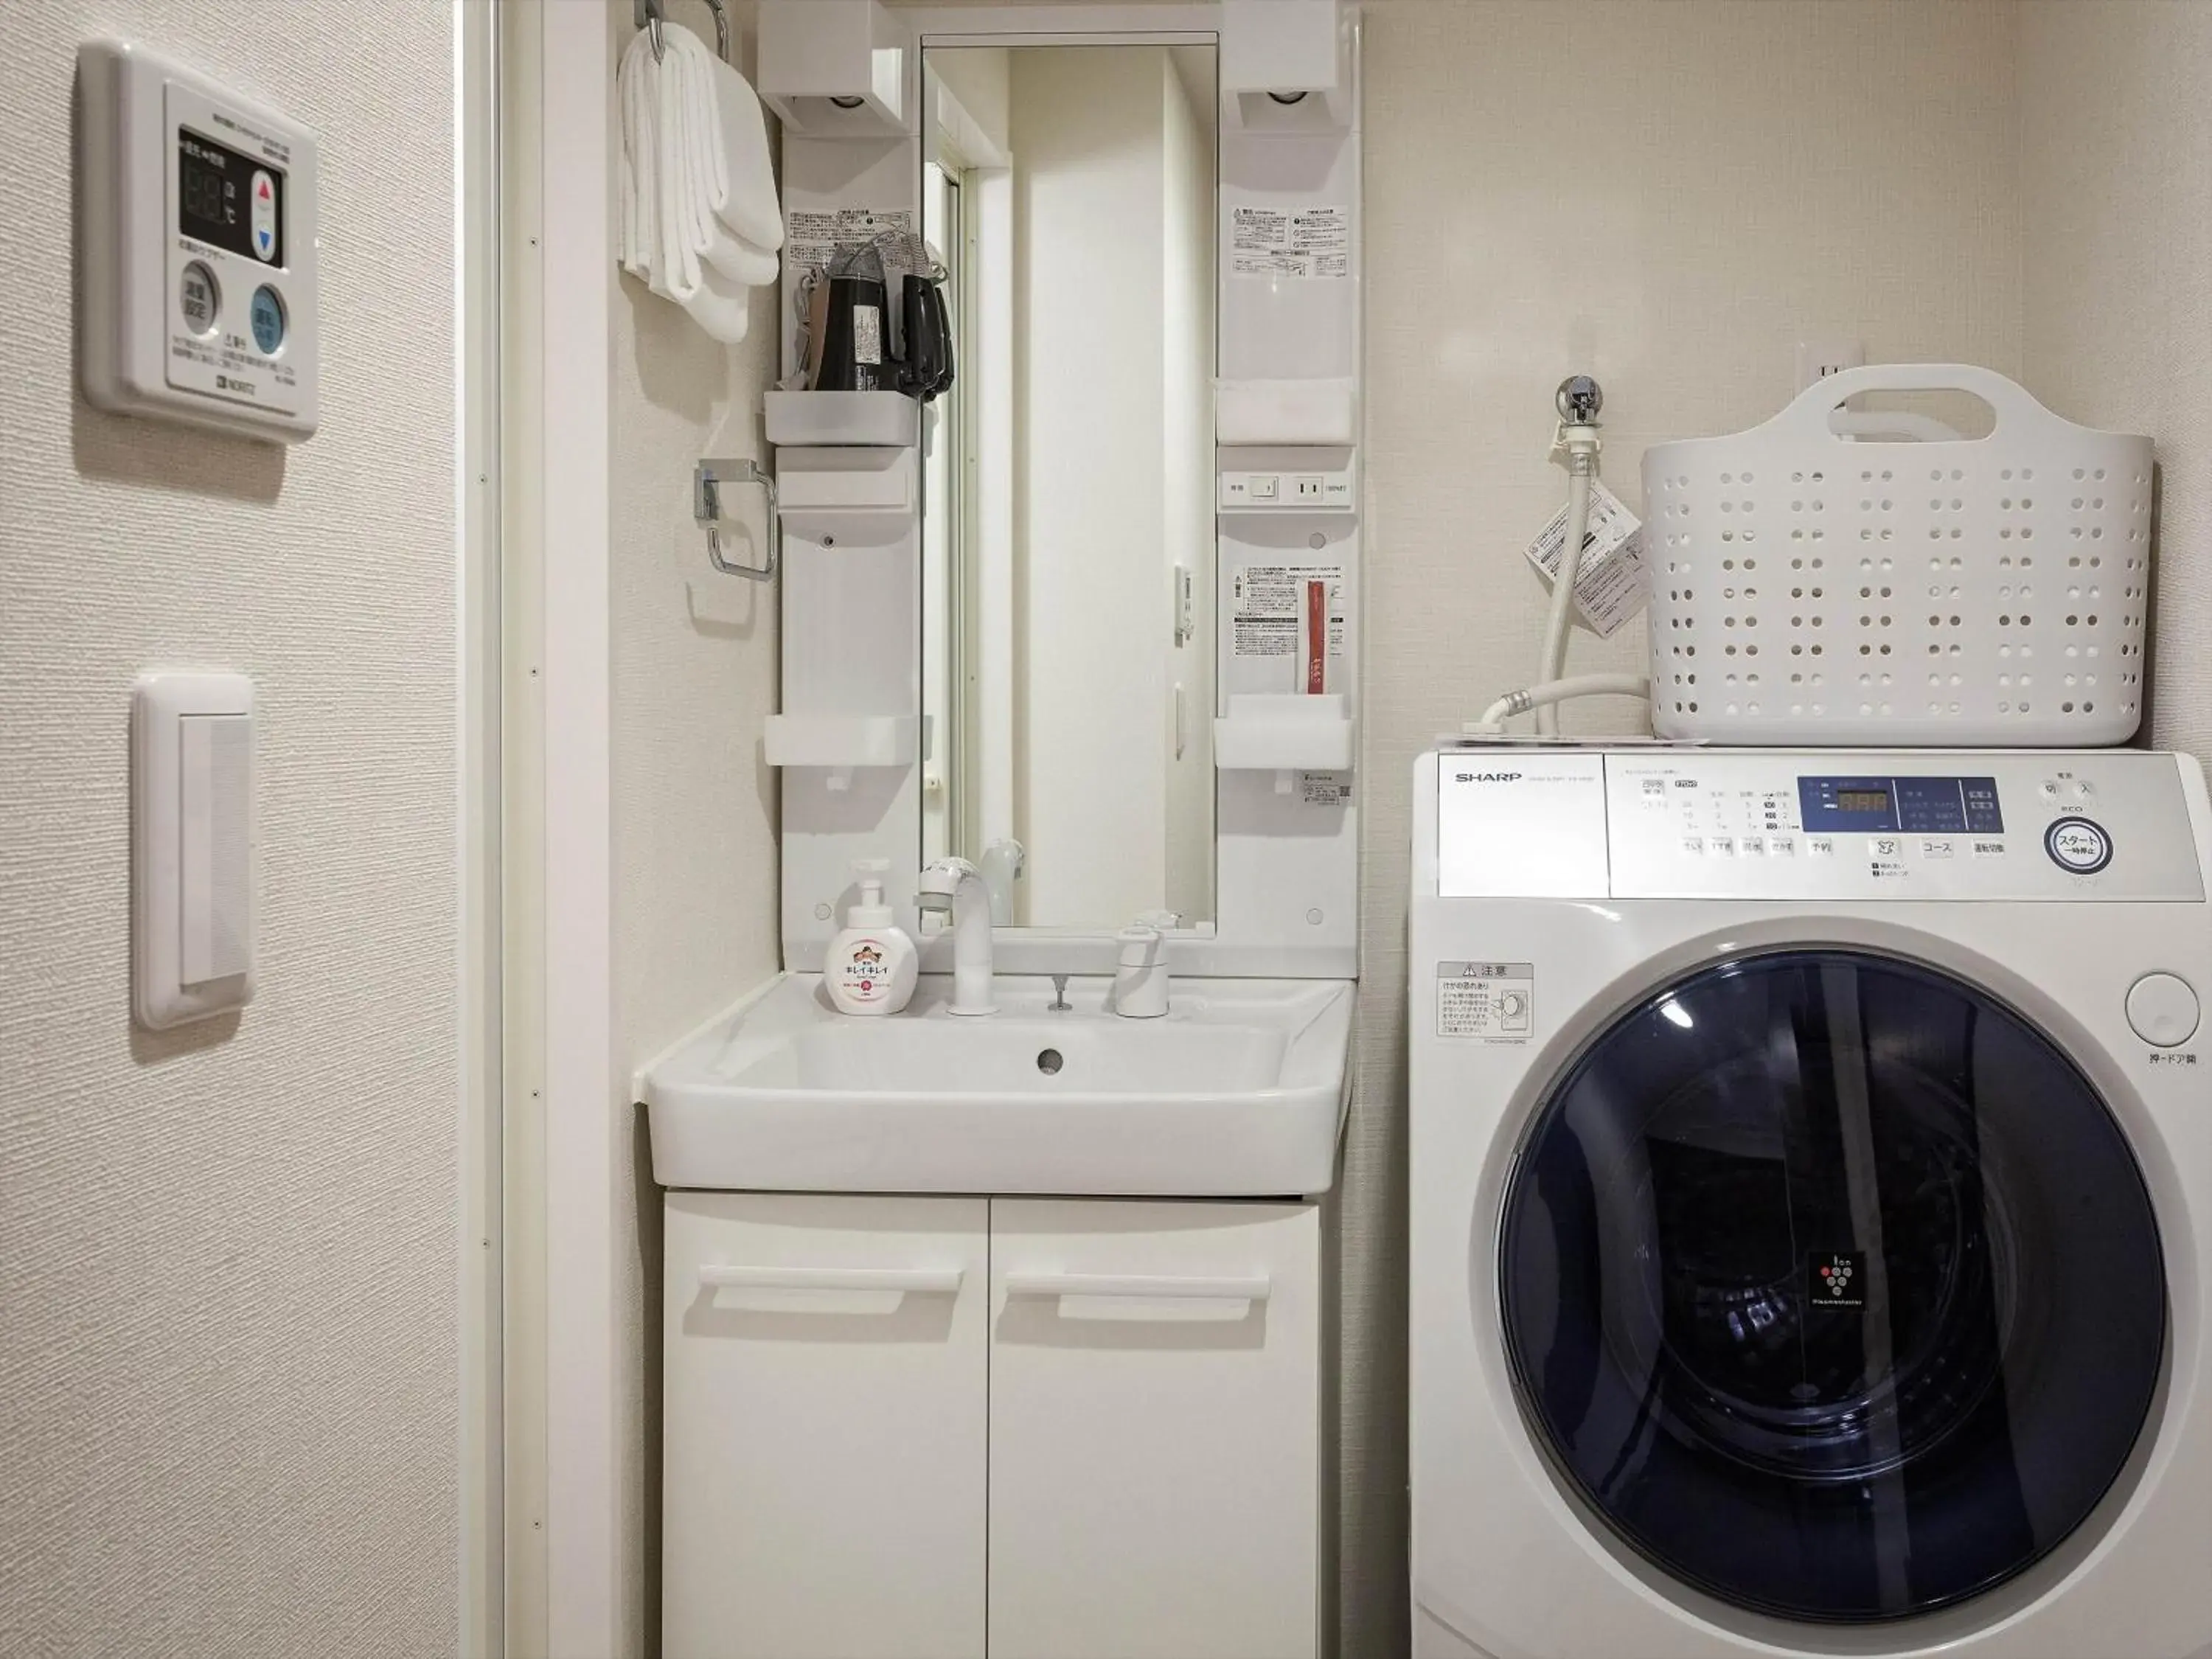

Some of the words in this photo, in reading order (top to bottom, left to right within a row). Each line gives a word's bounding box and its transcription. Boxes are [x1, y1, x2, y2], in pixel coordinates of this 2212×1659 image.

[1455, 773, 1523, 782] SHARP
[2059, 835, 2098, 846] スタート
[1924, 843, 1952, 852] コース
[1481, 965, 1507, 976] 注意
